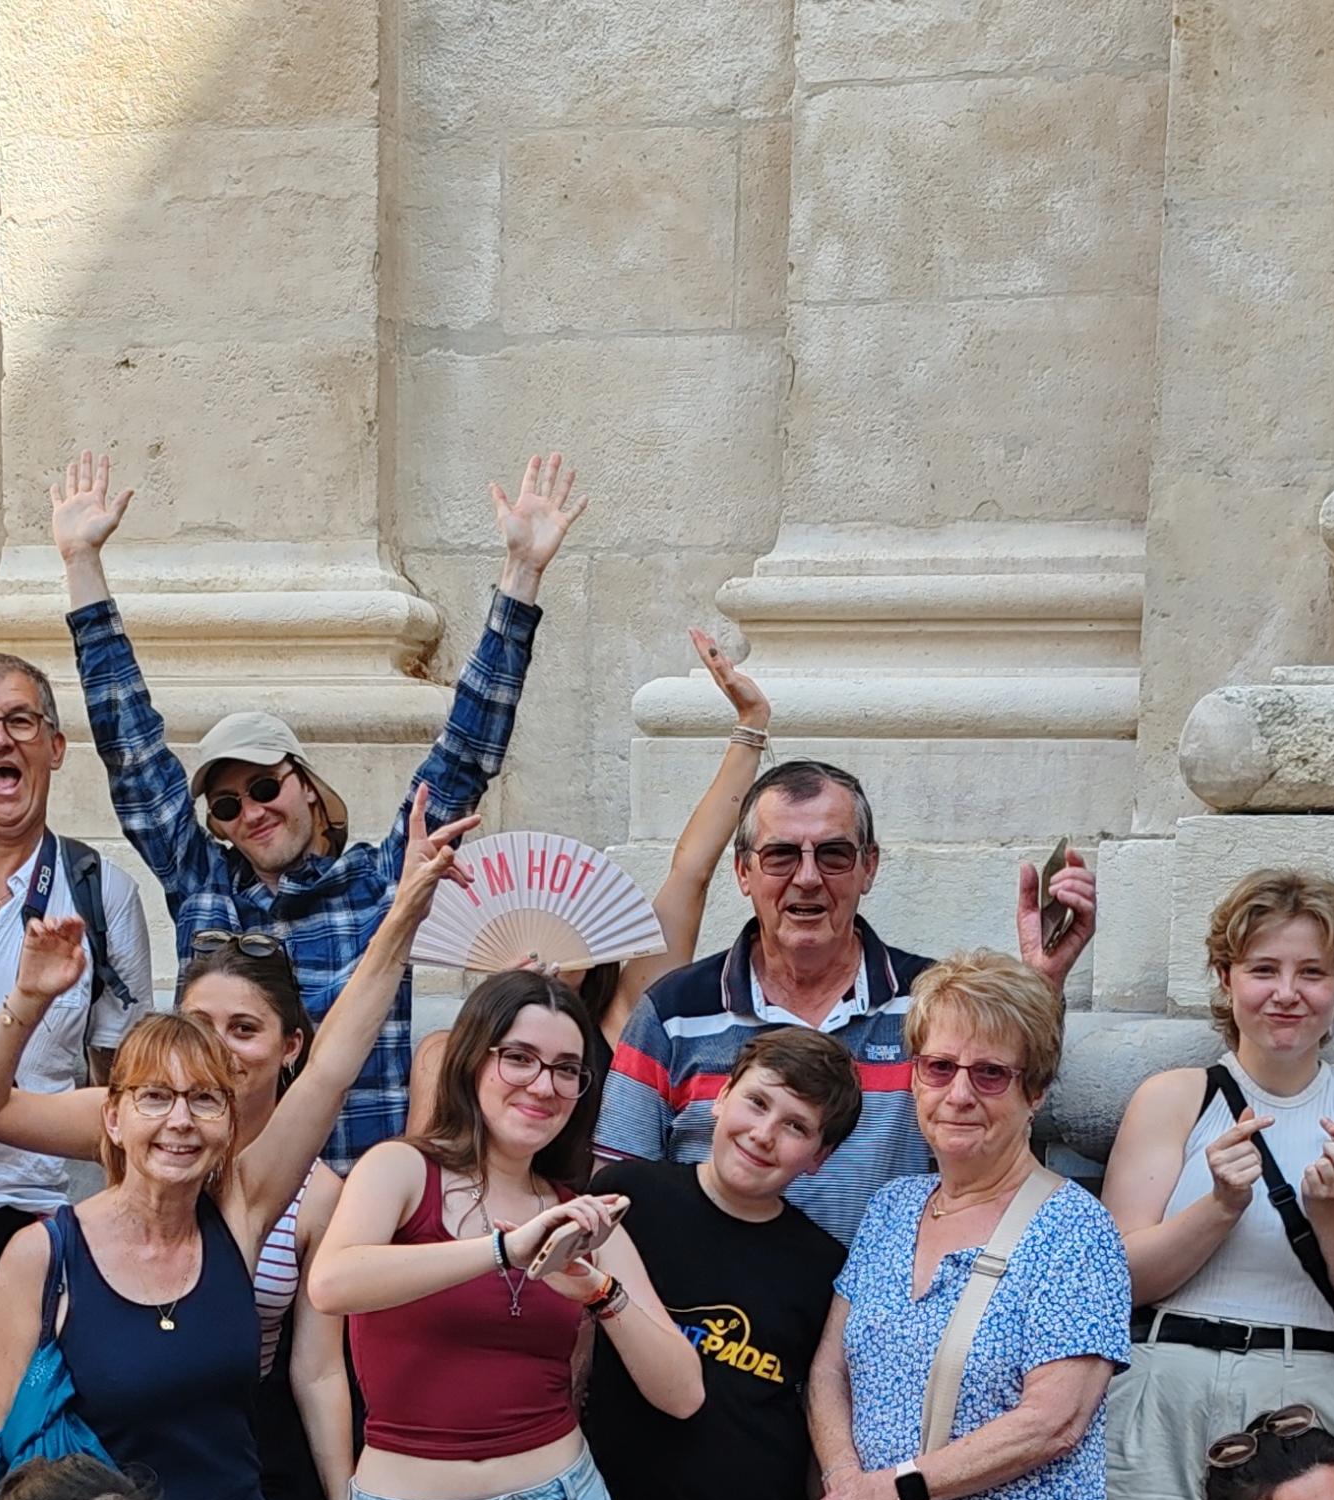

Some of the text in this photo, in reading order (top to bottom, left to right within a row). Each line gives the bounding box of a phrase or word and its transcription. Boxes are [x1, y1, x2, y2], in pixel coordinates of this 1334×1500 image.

[37, 865, 52, 896] EOS
[527, 849, 595, 900] HOT
[700, 1333, 784, 1383] PADEL
